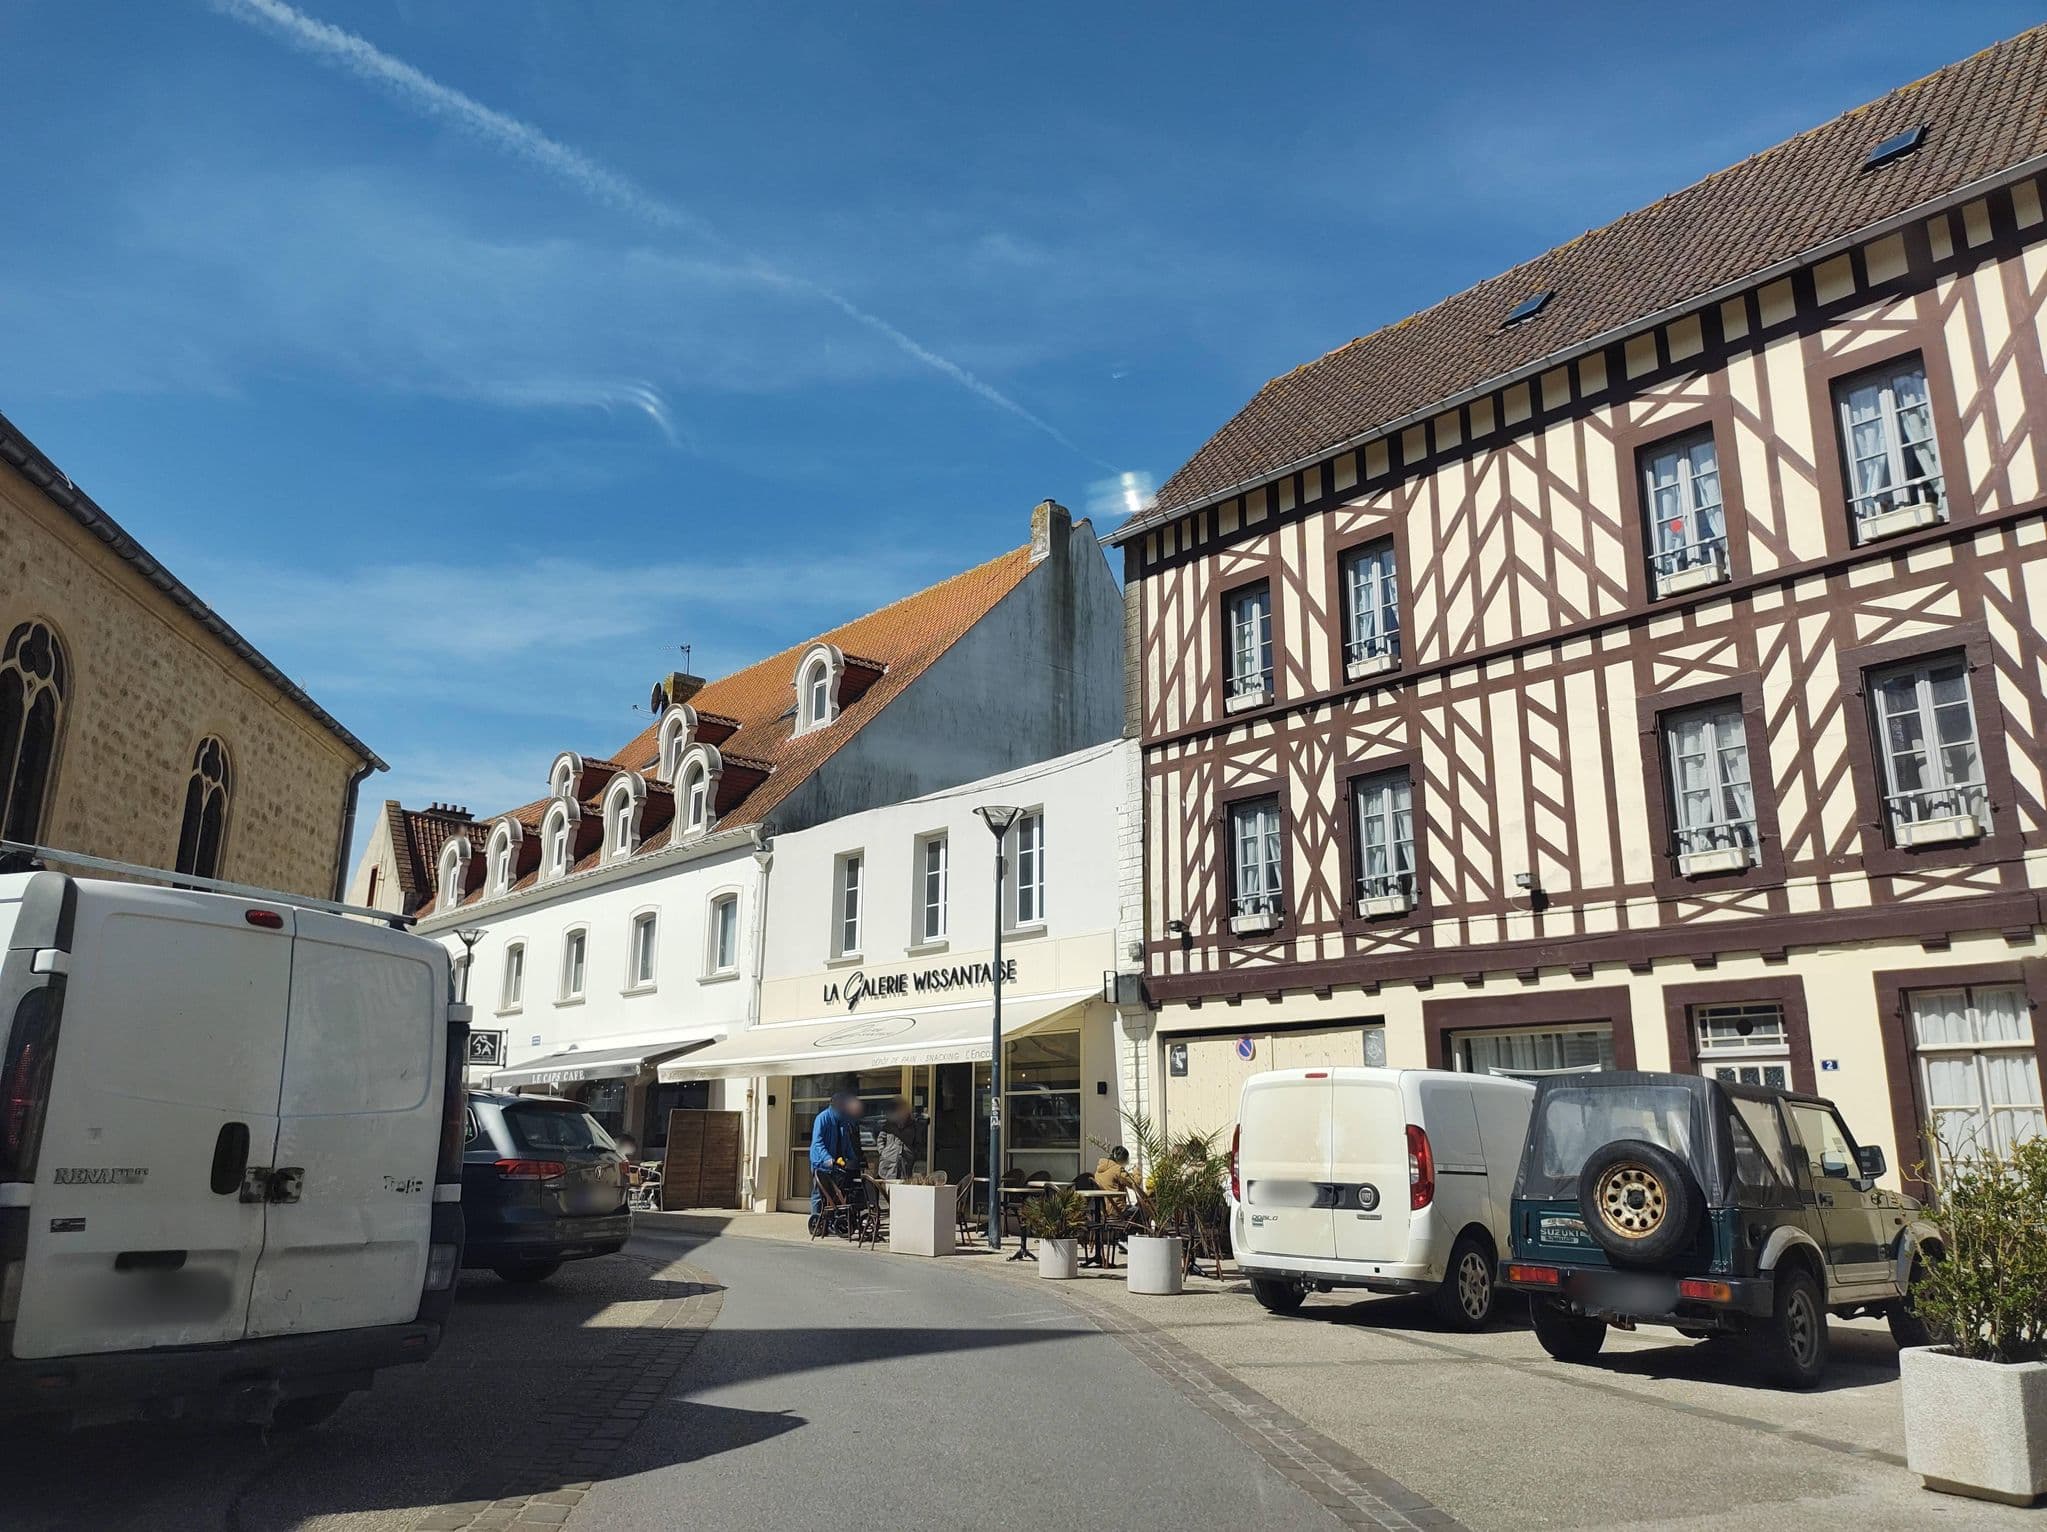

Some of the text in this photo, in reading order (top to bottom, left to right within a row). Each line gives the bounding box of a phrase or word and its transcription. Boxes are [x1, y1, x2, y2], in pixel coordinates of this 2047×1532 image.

[824, 983, 839, 1002] LA
[844, 971, 907, 1010] GALERIE
[474, 1043, 492, 1055] 3A
[1826, 1061, 1834, 1070] 2
[1540, 1228, 1579, 1237] SUZUKI
